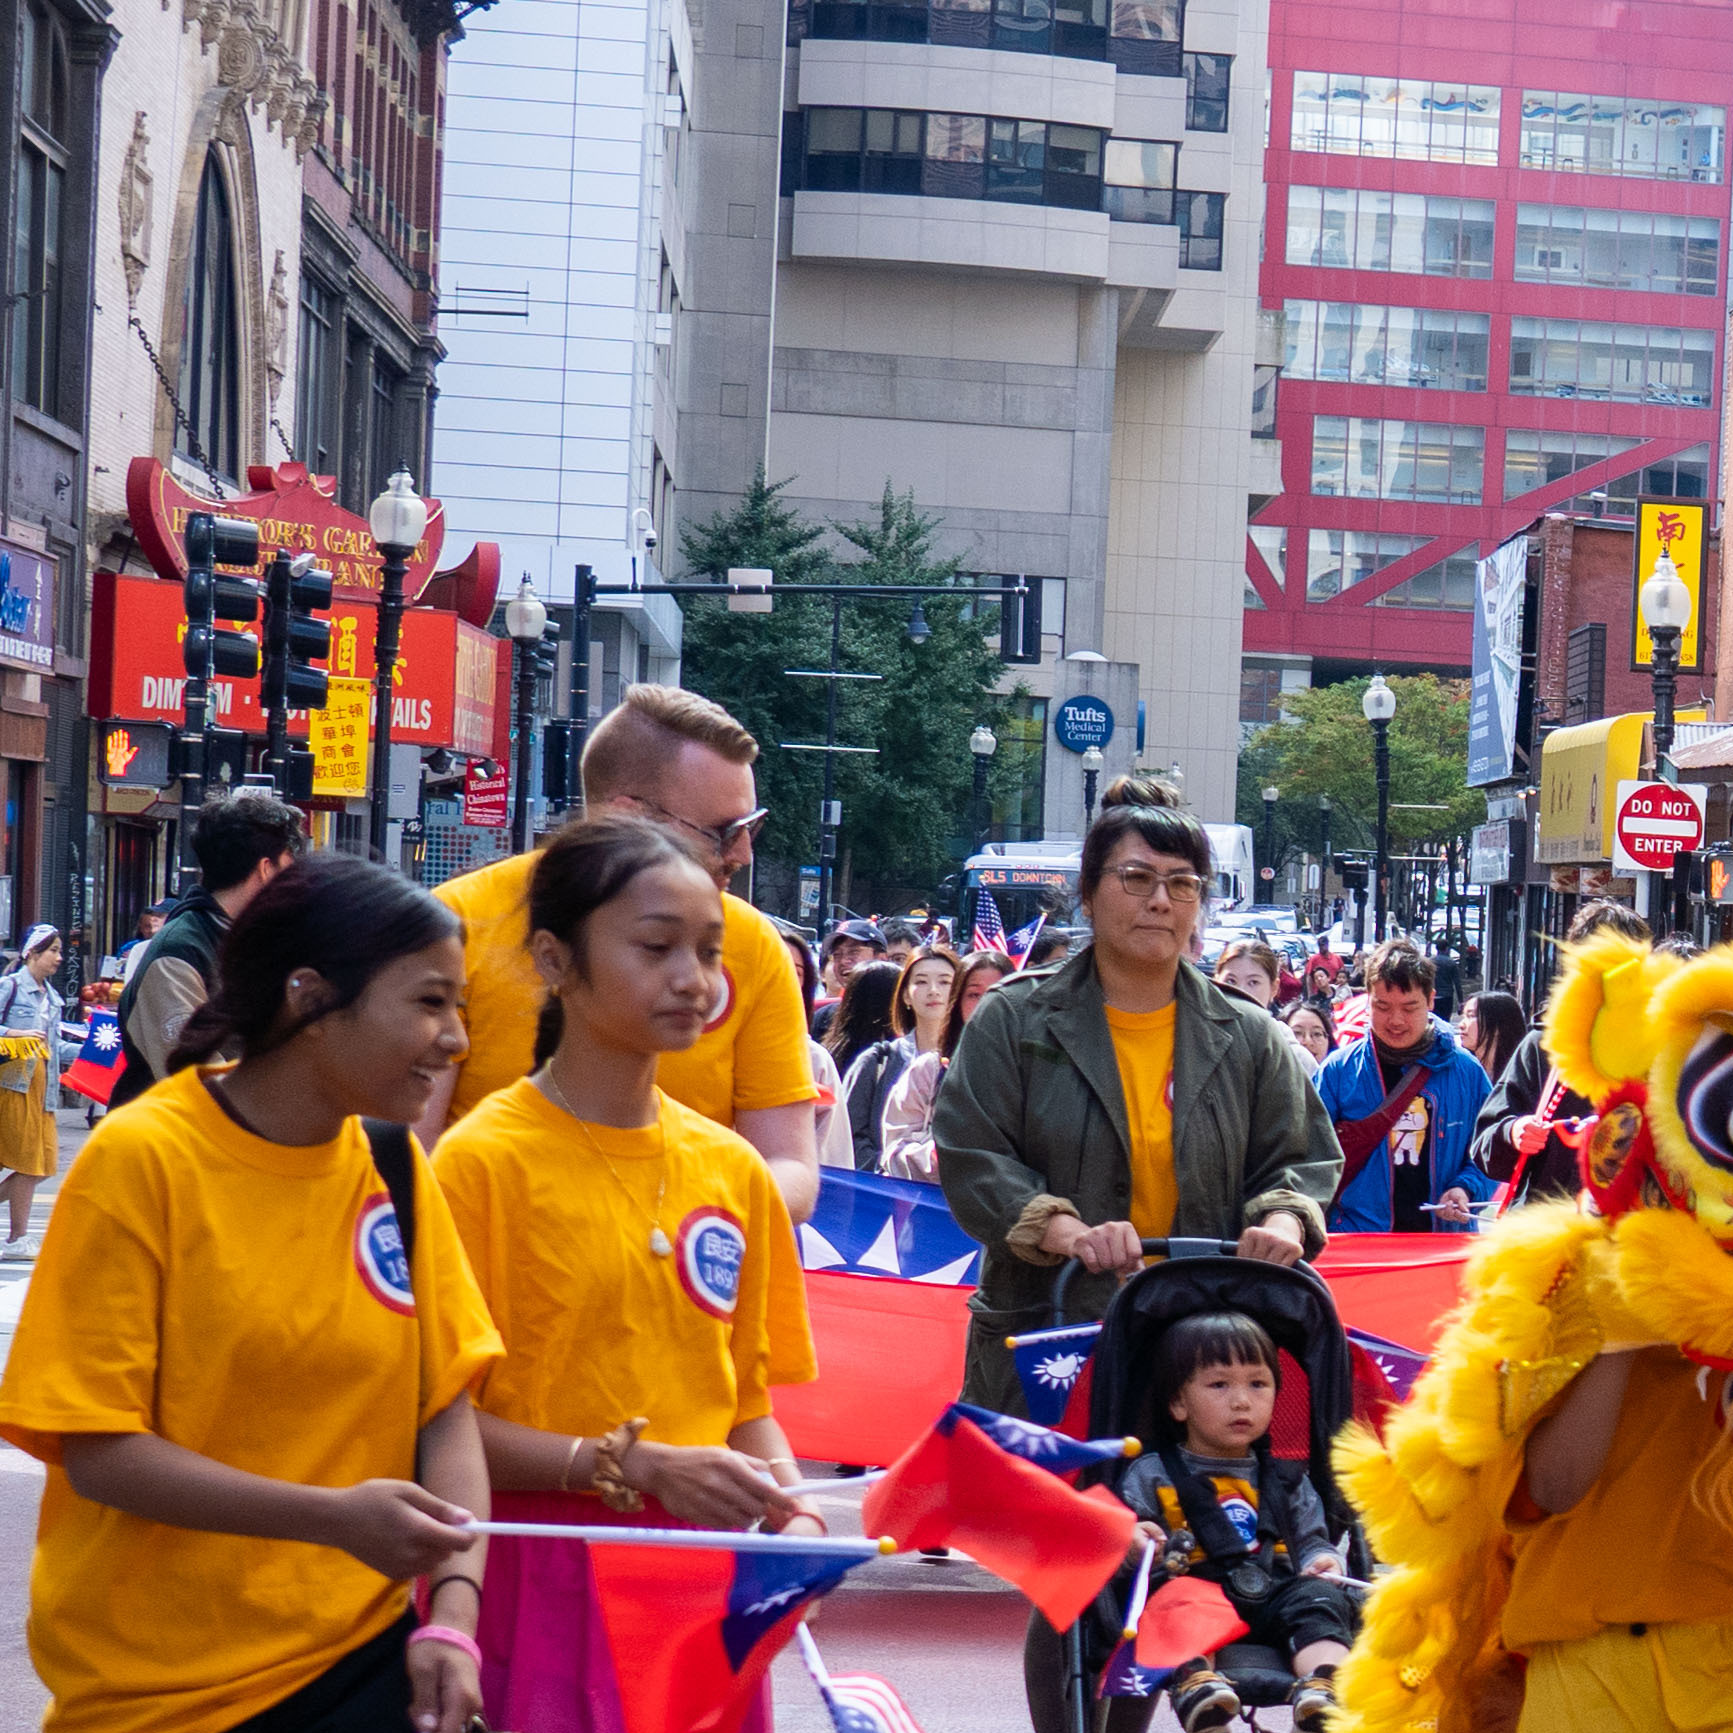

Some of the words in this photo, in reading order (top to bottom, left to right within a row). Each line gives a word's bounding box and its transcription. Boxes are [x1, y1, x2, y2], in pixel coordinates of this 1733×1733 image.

[142, 676, 184, 711] DIM
[1064, 707, 1106, 722] Tufts
[1064, 721, 1106, 732] Medical
[1067, 731, 1102, 742] Center
[467, 793, 506, 804] Chinatown
[1631, 799, 1653, 814] DO
[1661, 802, 1692, 817] NOT
[1634, 838, 1683, 854] ENTER
[984, 870, 1006, 883] SL5
[1013, 872, 1067, 884] DOWNTOWN
[374, 1224, 403, 1253] 良
[704, 1262, 737, 1289] 189
